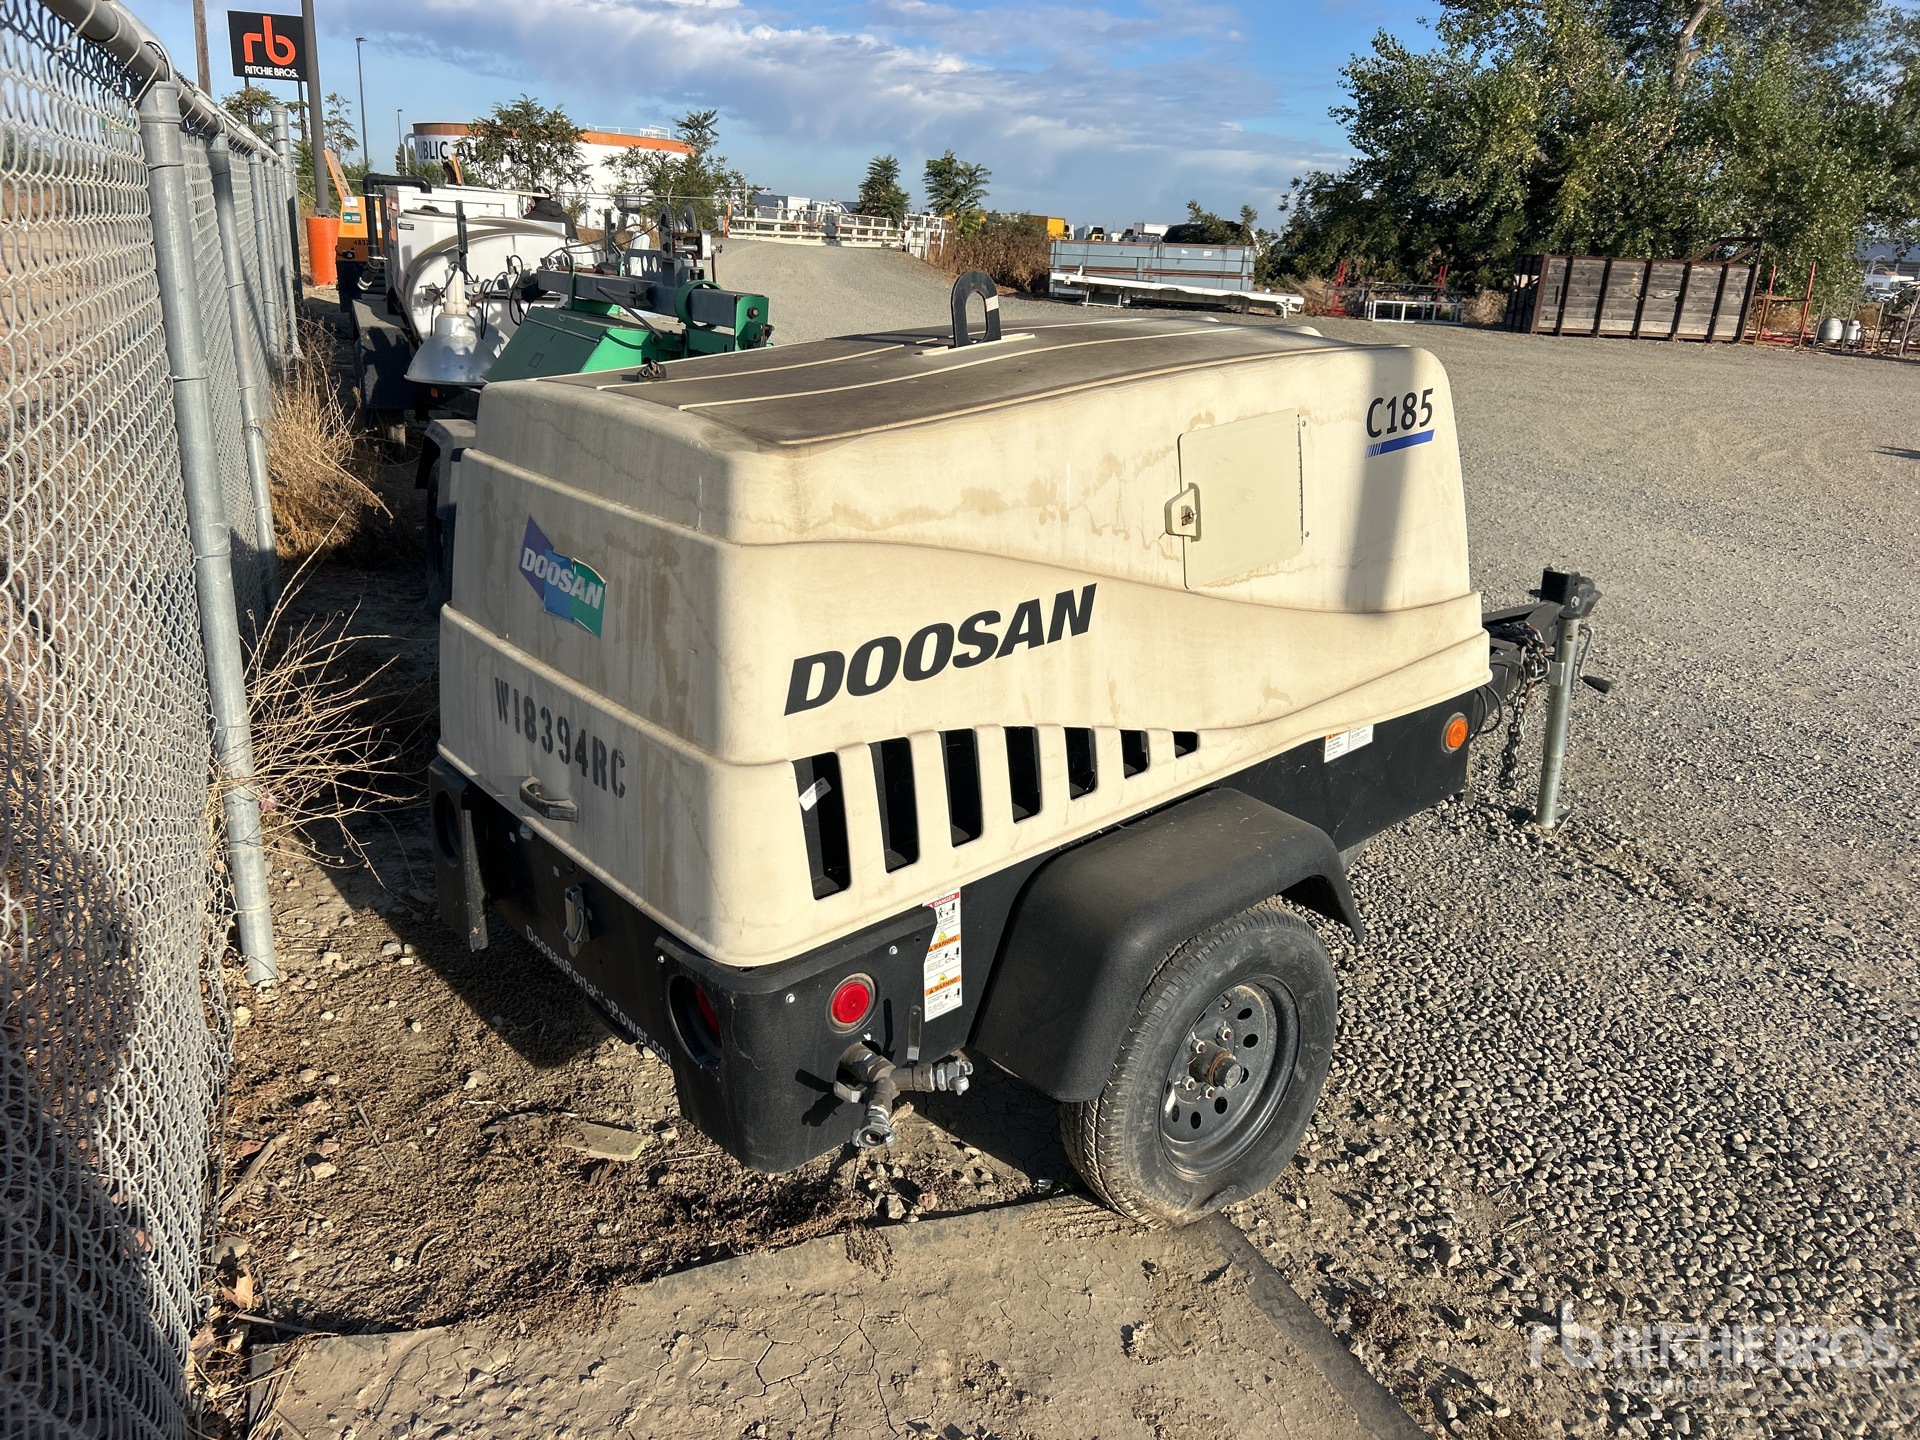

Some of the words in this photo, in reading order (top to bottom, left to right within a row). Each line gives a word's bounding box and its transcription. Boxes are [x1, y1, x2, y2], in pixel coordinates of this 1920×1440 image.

[243, 15, 296, 66] rb
[244, 65, 273, 76] RITCHIE
[274, 67, 299, 78] BROS.
[1366, 388, 1433, 438] C185
[521, 547, 604, 610] DOOSAN
[784, 583, 1097, 716] DOOSAN
[934, 936, 957, 949] WARNING
[935, 977, 958, 991] WARNING
